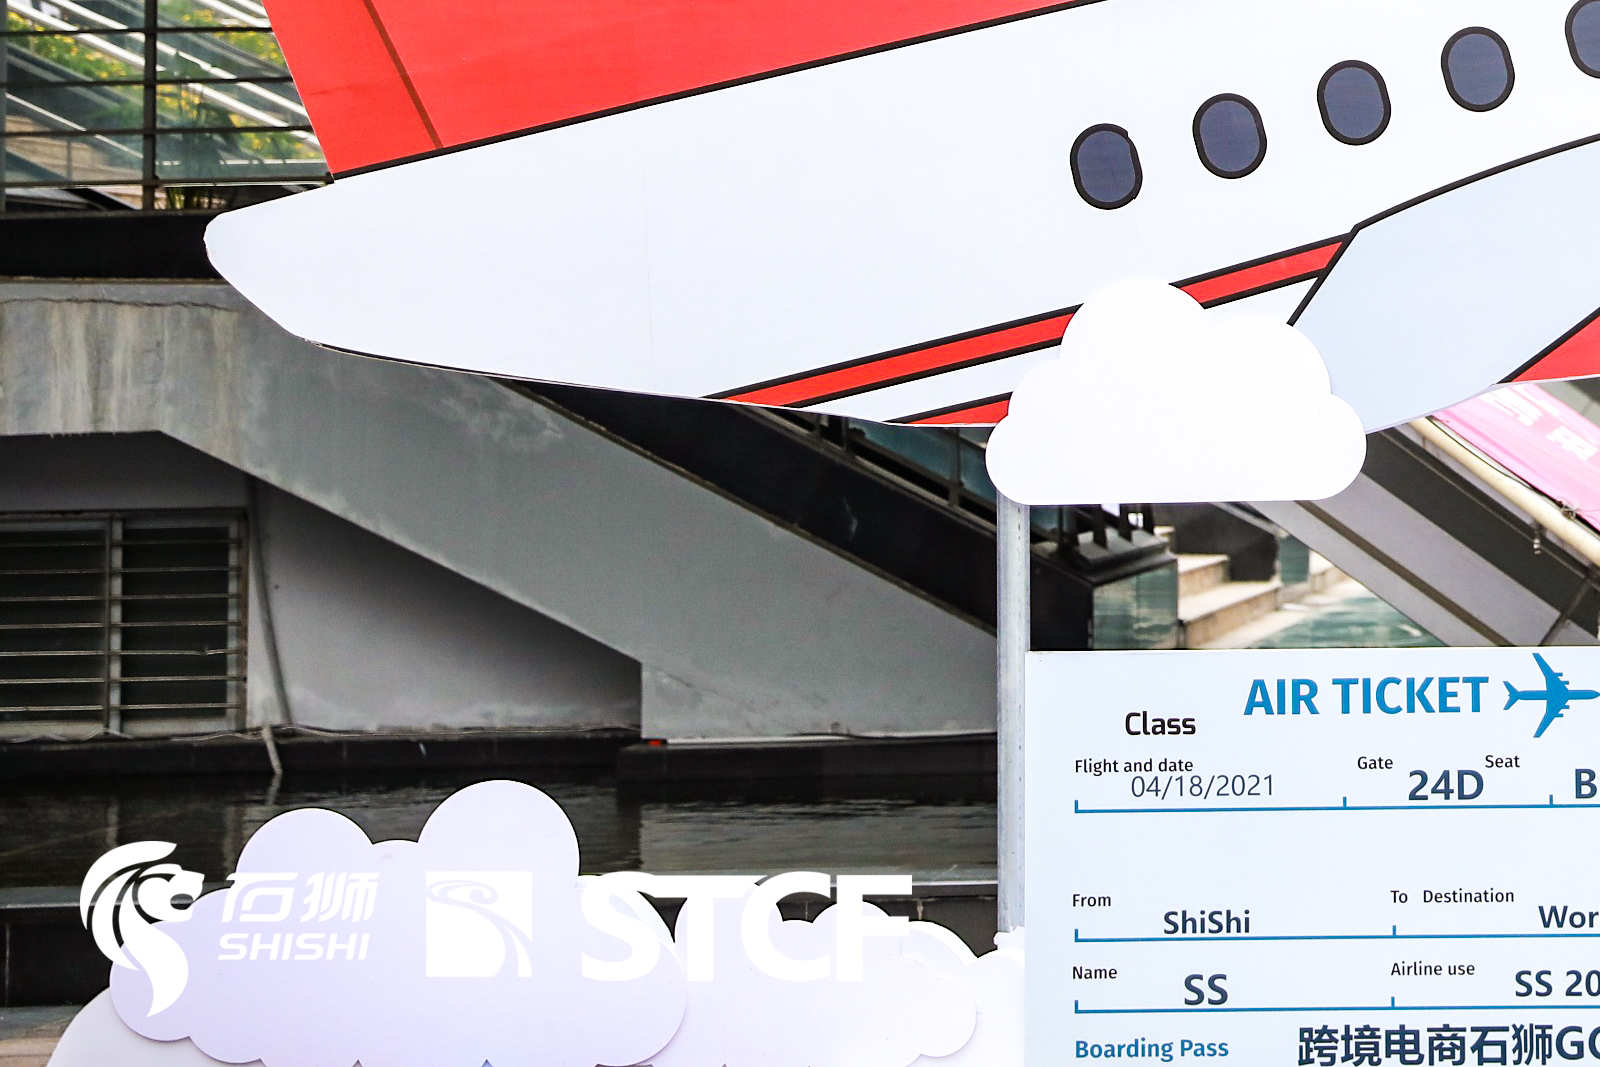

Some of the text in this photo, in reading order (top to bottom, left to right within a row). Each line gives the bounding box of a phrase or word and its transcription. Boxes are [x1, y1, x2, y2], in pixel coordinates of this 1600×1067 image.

[1243, 676, 1490, 716] AIR TICKET
[1125, 710, 1197, 736] Class
[1074, 757, 1195, 777] Flight and date
[1356, 755, 1394, 771] Gate
[1484, 753, 1521, 770] Seat
[1130, 774, 1275, 800] 04/18/2021
[1408, 769, 1485, 802] 24D
[1071, 892, 1112, 909] From
[1390, 887, 1516, 905] To Destination
[1162, 908, 1252, 935] ShiShi
[1071, 965, 1119, 981] Name
[1389, 960, 1476, 977] Airline use
[1183, 973, 1229, 1007] SS
[1514, 968, 1554, 998] SS
[1074, 1037, 1230, 1064] Boarding Pass
